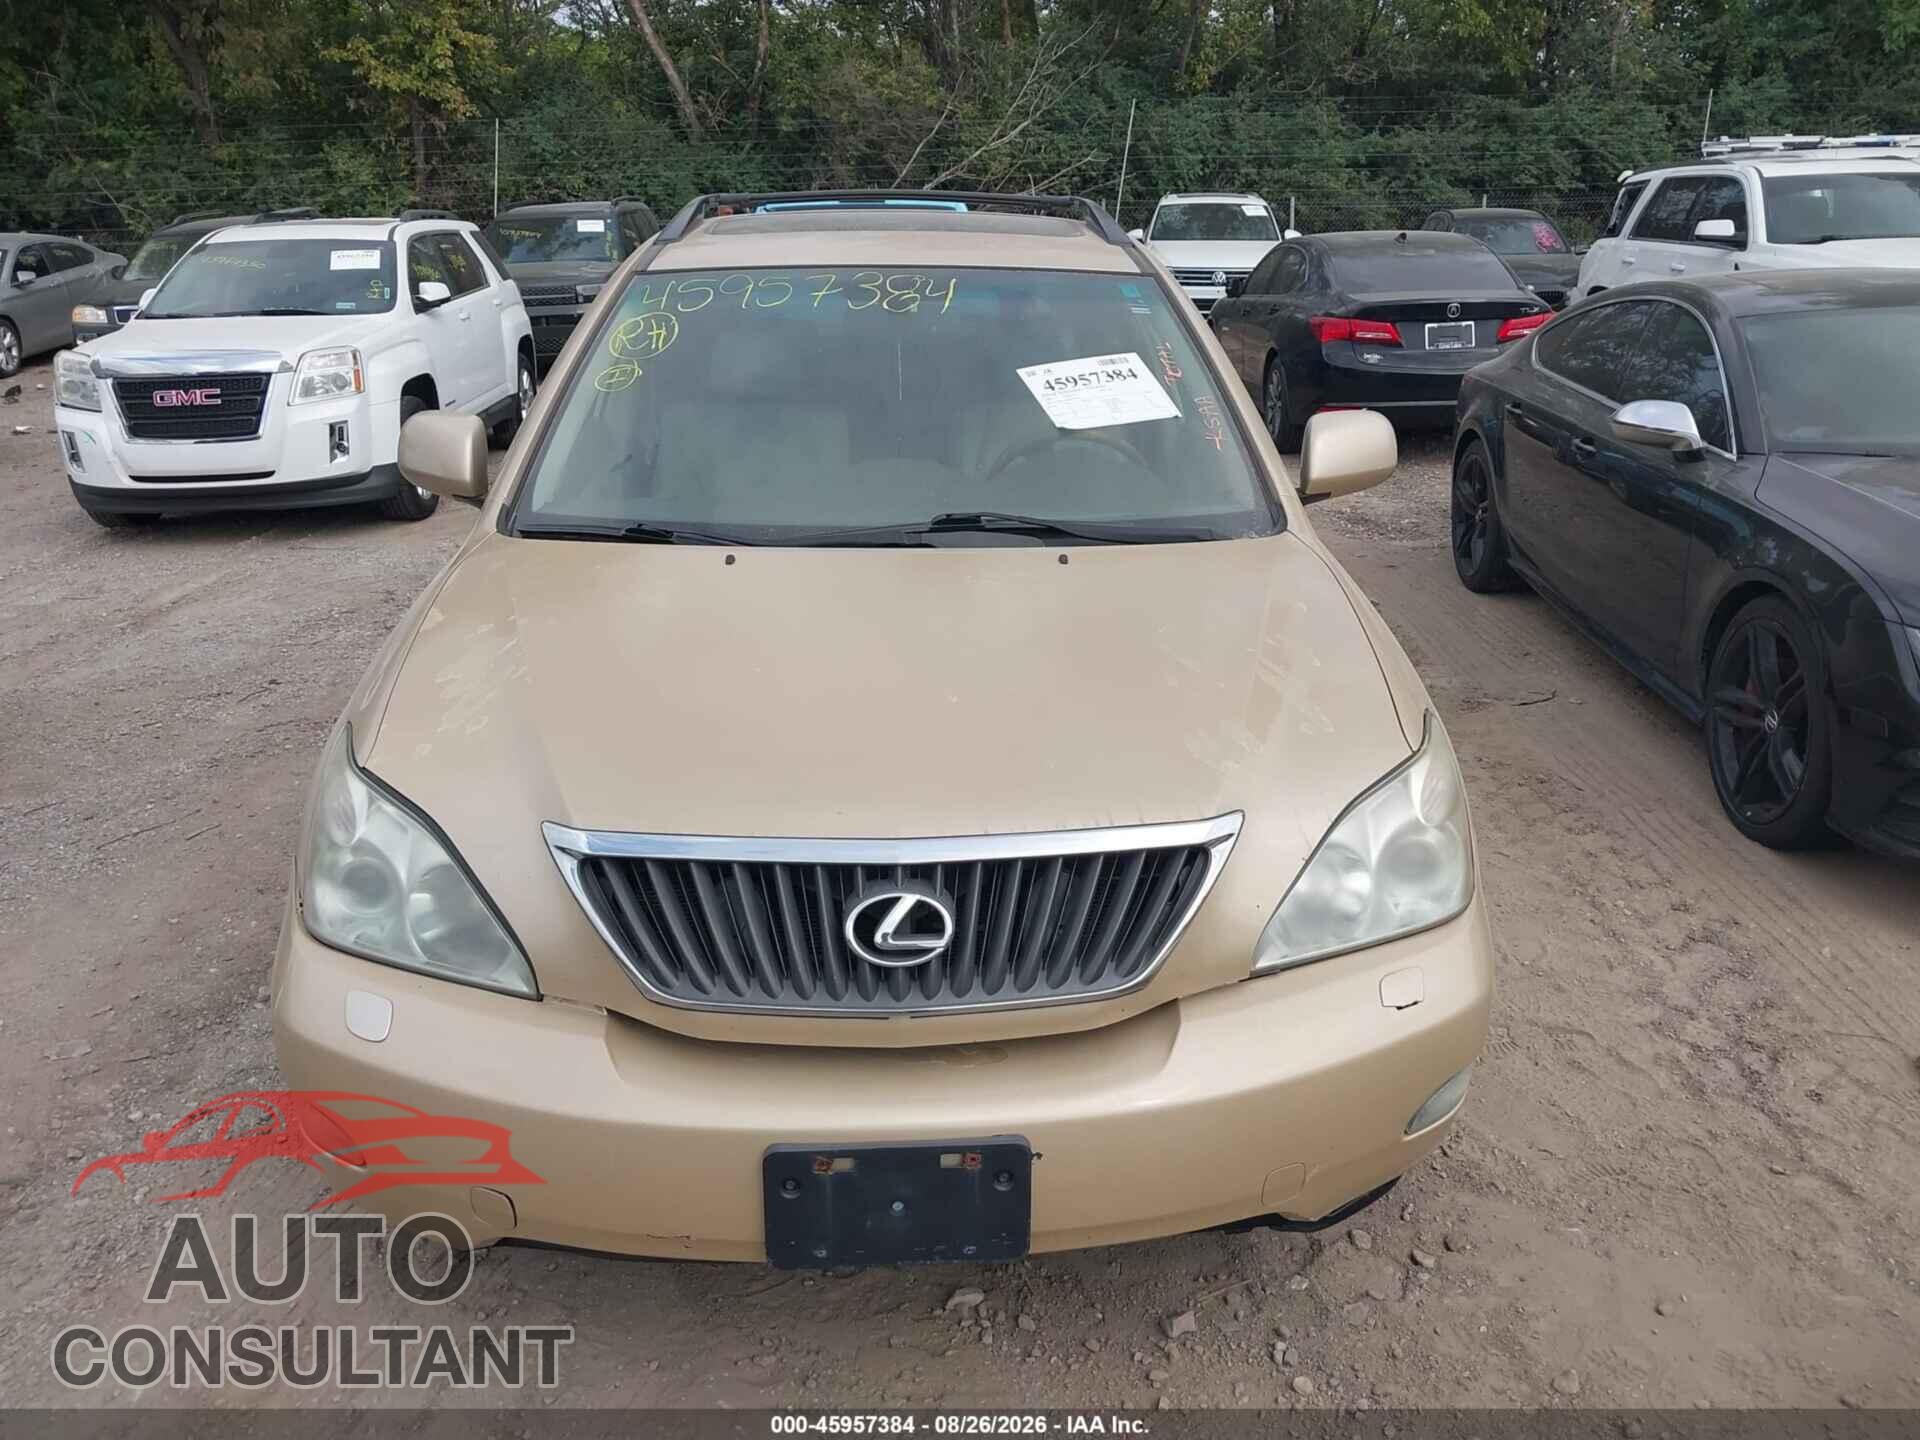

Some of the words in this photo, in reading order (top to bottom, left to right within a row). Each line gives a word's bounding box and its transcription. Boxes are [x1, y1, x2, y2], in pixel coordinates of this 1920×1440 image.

[641, 271, 957, 314] 45957384
[1042, 367, 1139, 392] 45957384
[152, 388, 222, 407] GMC
